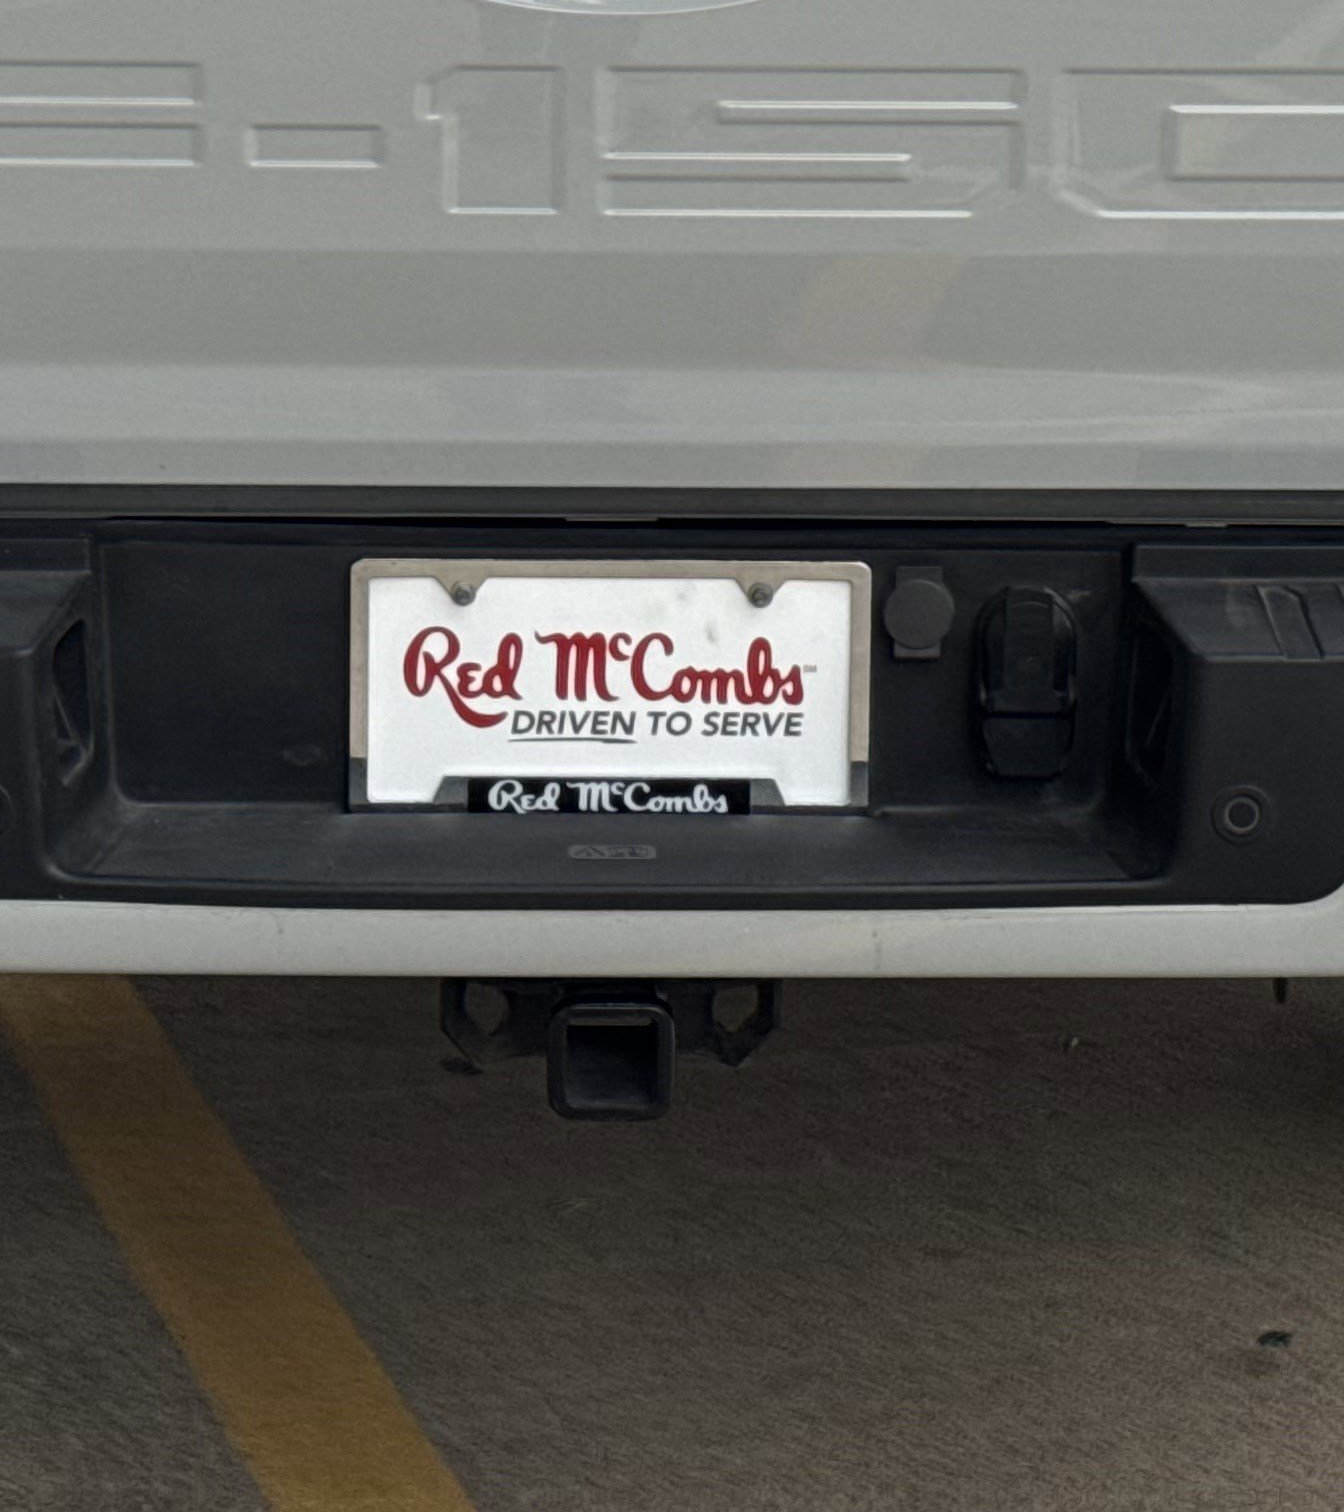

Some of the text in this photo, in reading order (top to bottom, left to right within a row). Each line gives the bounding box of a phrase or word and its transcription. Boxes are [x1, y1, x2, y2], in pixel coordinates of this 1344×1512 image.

[403, 626, 524, 728] Red
[534, 630, 805, 705] McCombs
[510, 709, 804, 738] DRIVEN TO SERVE
[487, 778, 729, 815] Red McCombs
